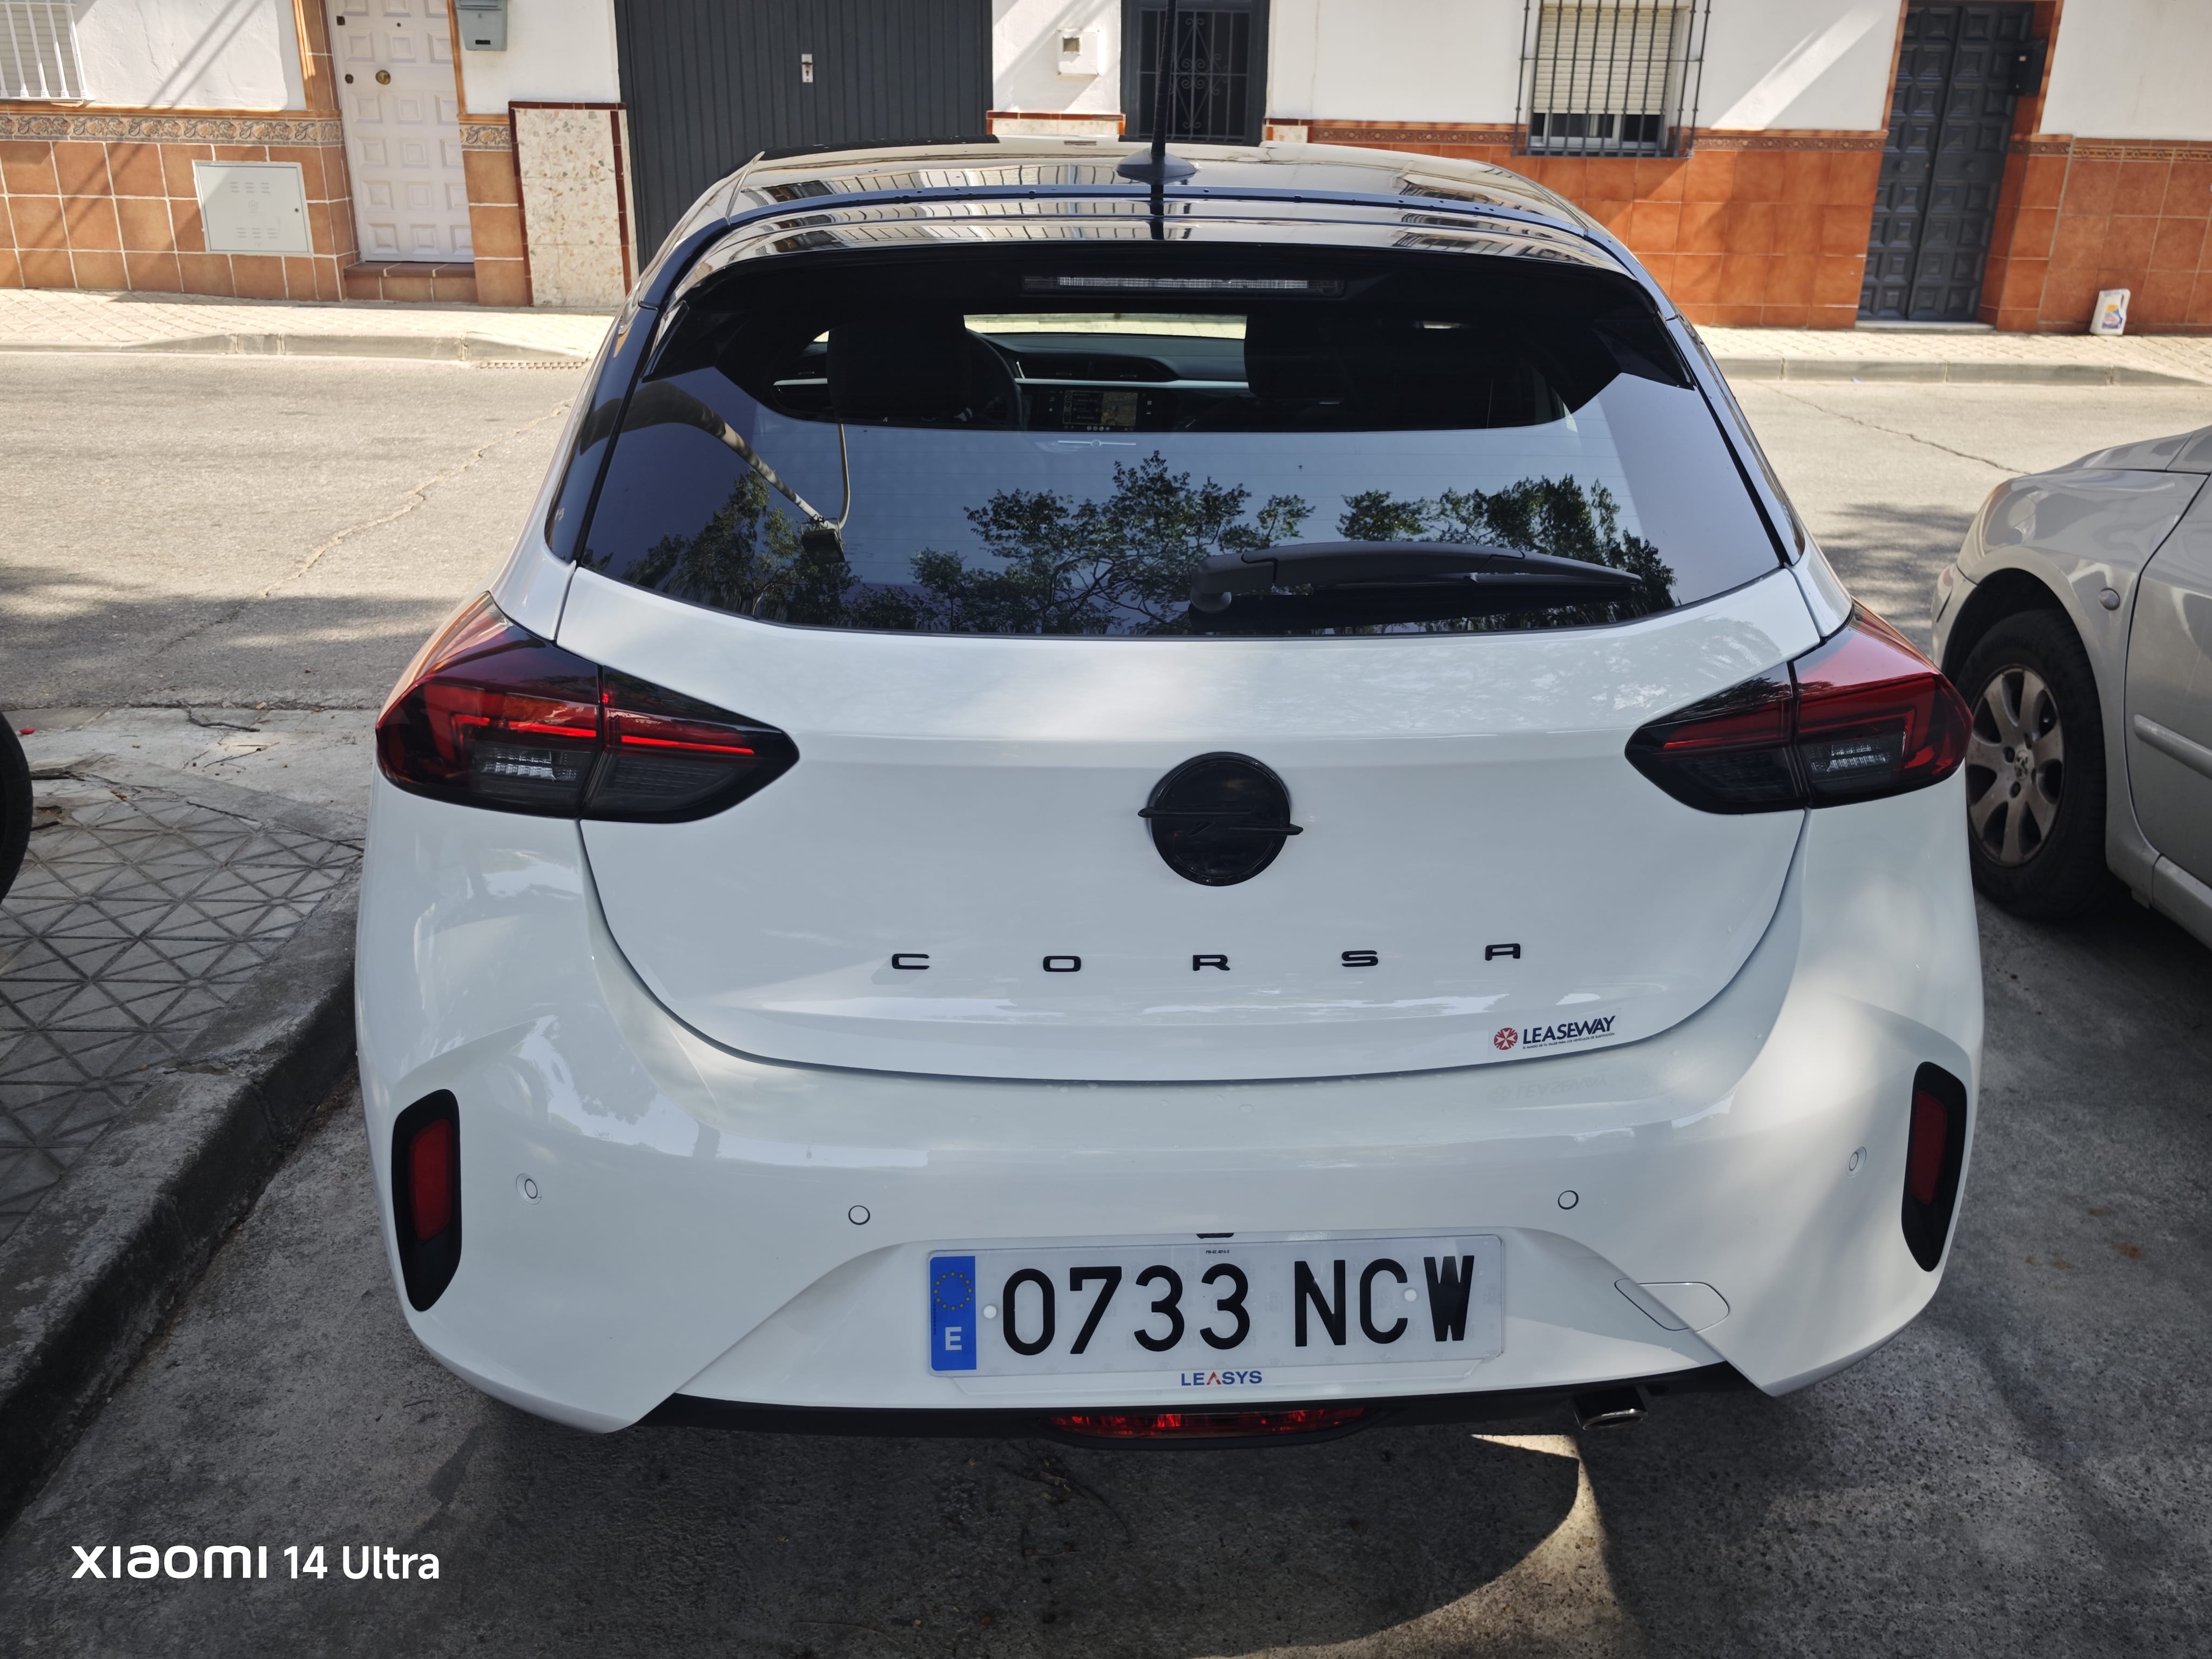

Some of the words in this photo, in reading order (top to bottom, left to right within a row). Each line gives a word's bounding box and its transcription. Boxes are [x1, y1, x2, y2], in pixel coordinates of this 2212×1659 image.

[891, 943, 1521, 972] CORSA
[1523, 1015, 1616, 1044] LEASEWAY
[1002, 1263, 1250, 1355] 0733
[1294, 1255, 1475, 1347] NCW
[945, 1325, 962, 1351] E
[1181, 1370, 1263, 1386] LEASYS
